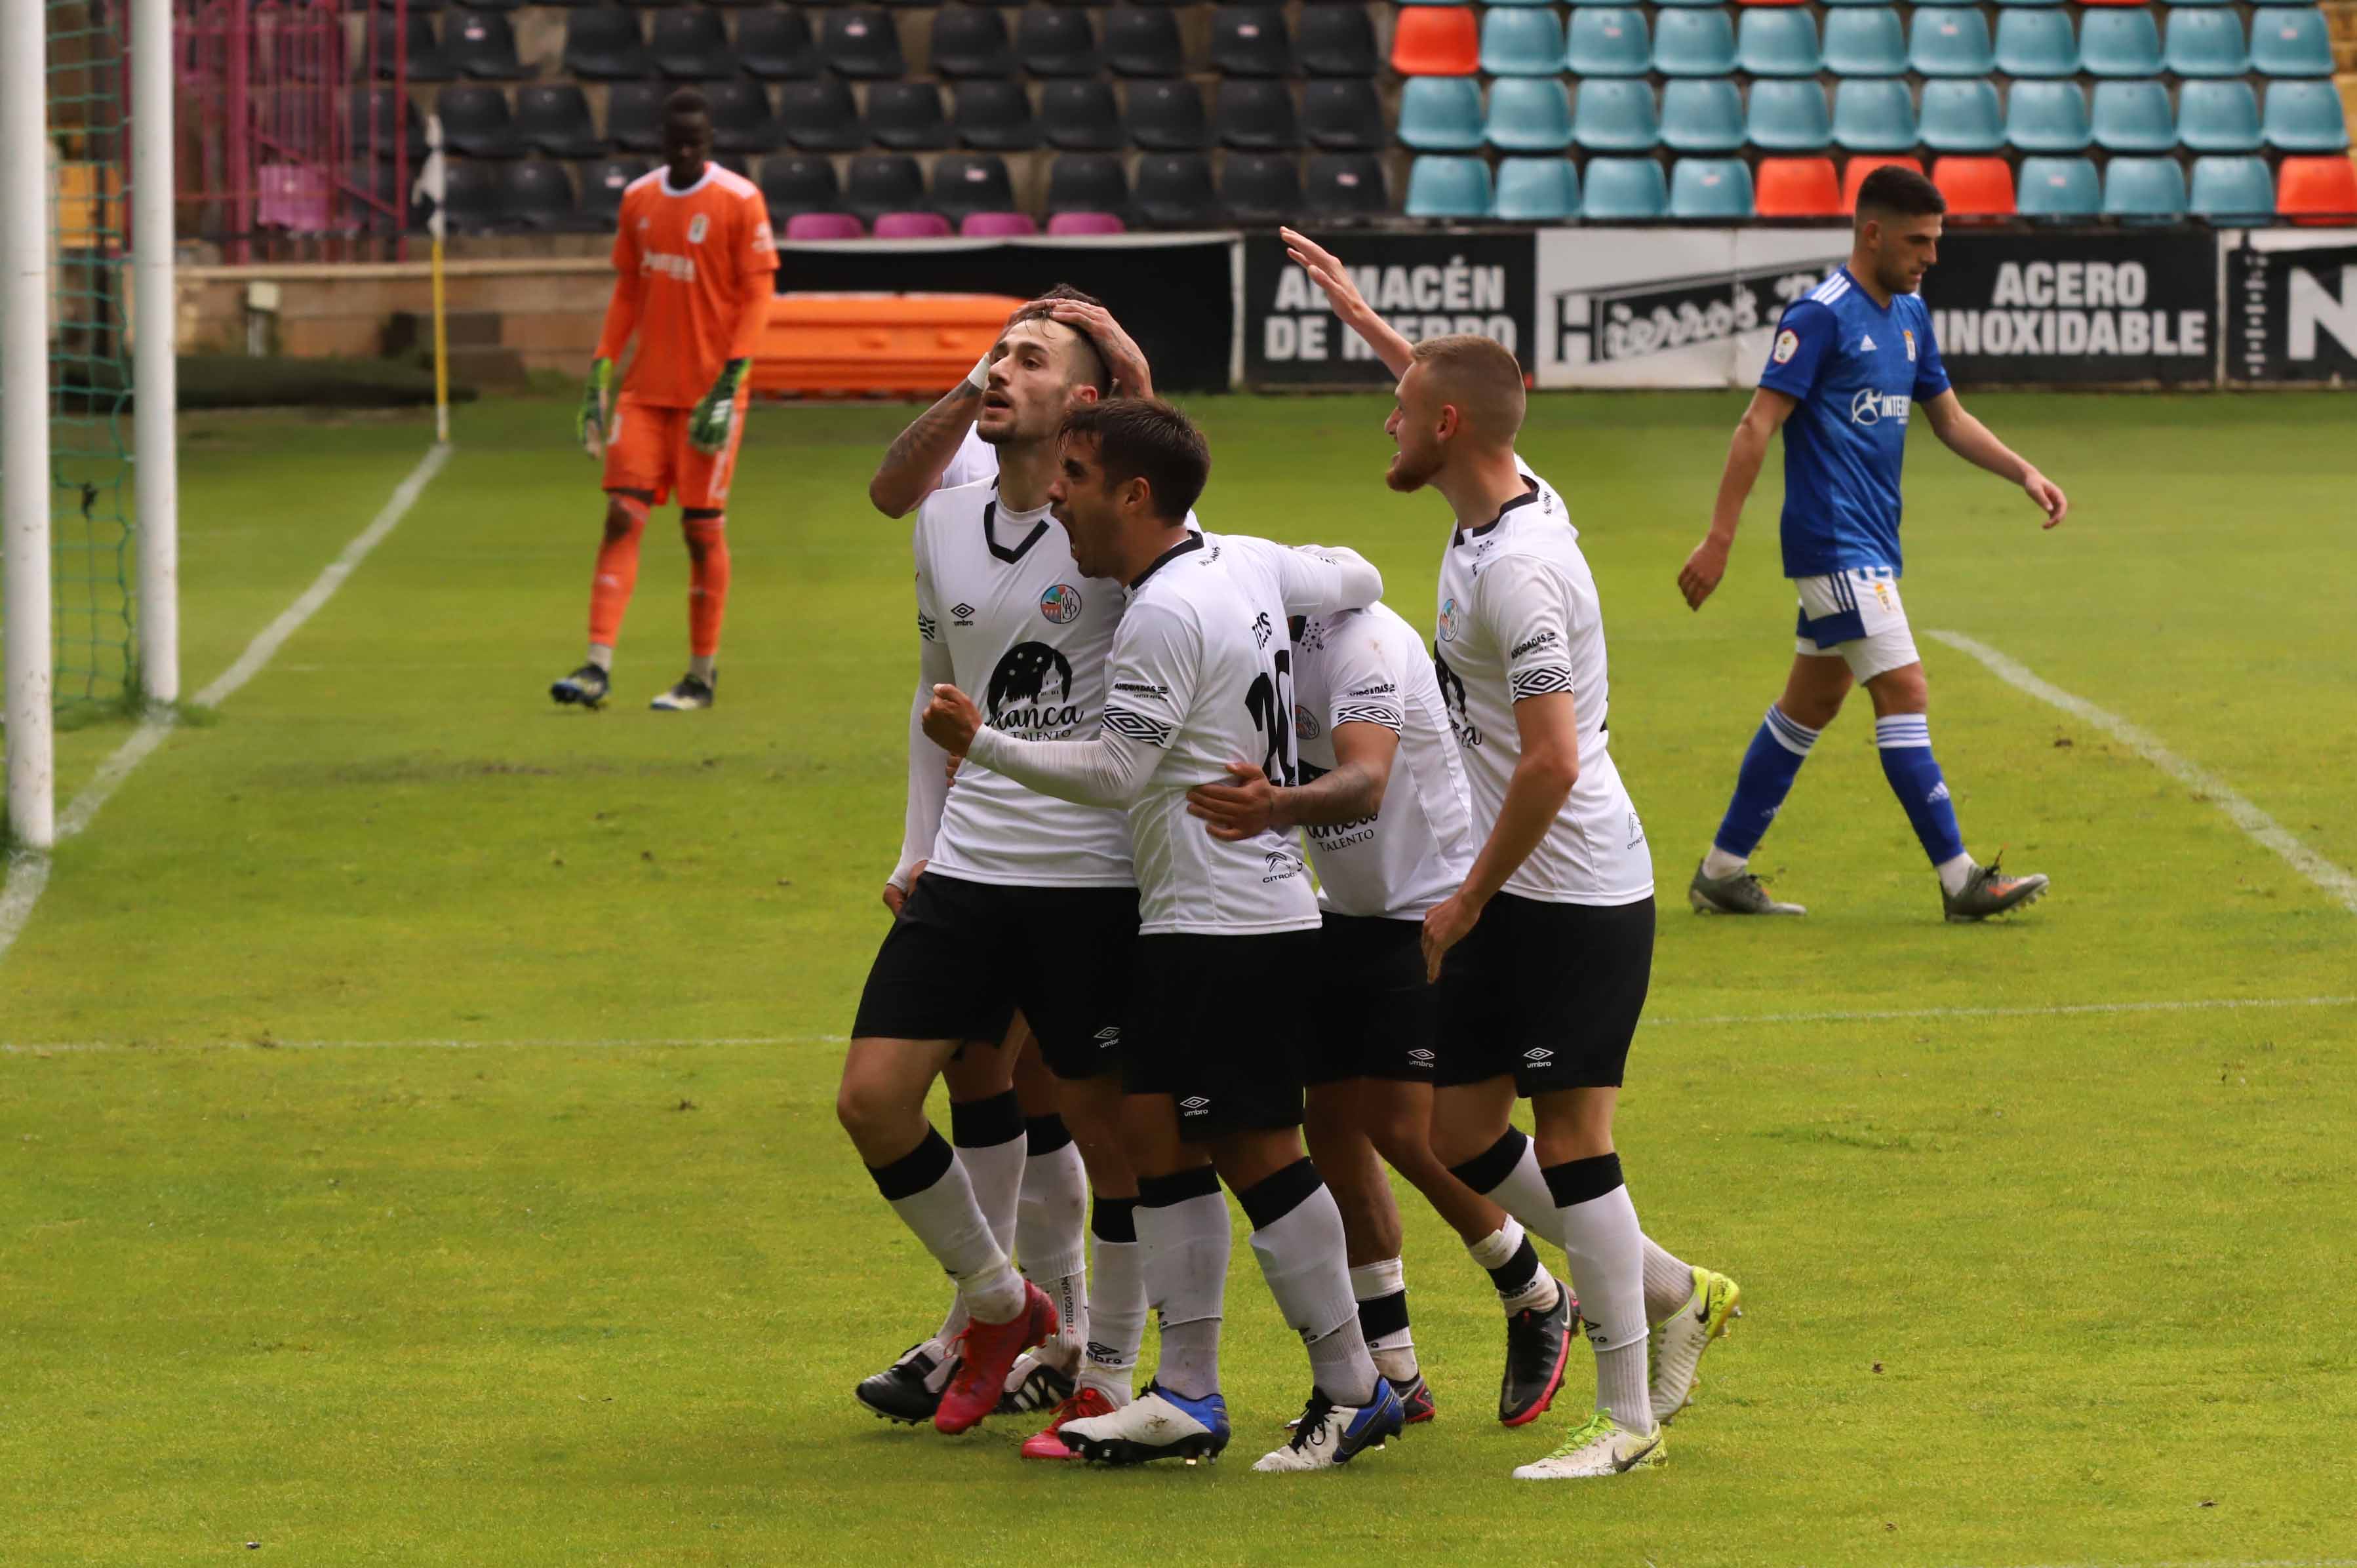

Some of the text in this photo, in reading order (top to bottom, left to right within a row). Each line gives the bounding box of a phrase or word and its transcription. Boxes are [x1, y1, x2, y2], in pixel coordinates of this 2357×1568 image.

[1991, 261, 2148, 307] ACERO
[1263, 314, 1518, 361] DE HERO
[1932, 309, 2208, 355] INOXIDABLE
[1010, 729, 1071, 742] TALENTO
[1317, 829, 1374, 853] TALENTO
[1099, 1038, 1120, 1048] umbr
[1408, 1059, 1434, 1068] umbro
[1183, 1108, 1209, 1117] umbro
[1064, 1296, 1074, 1323] DIEGO
[1086, 1350, 1122, 1364] mbro
